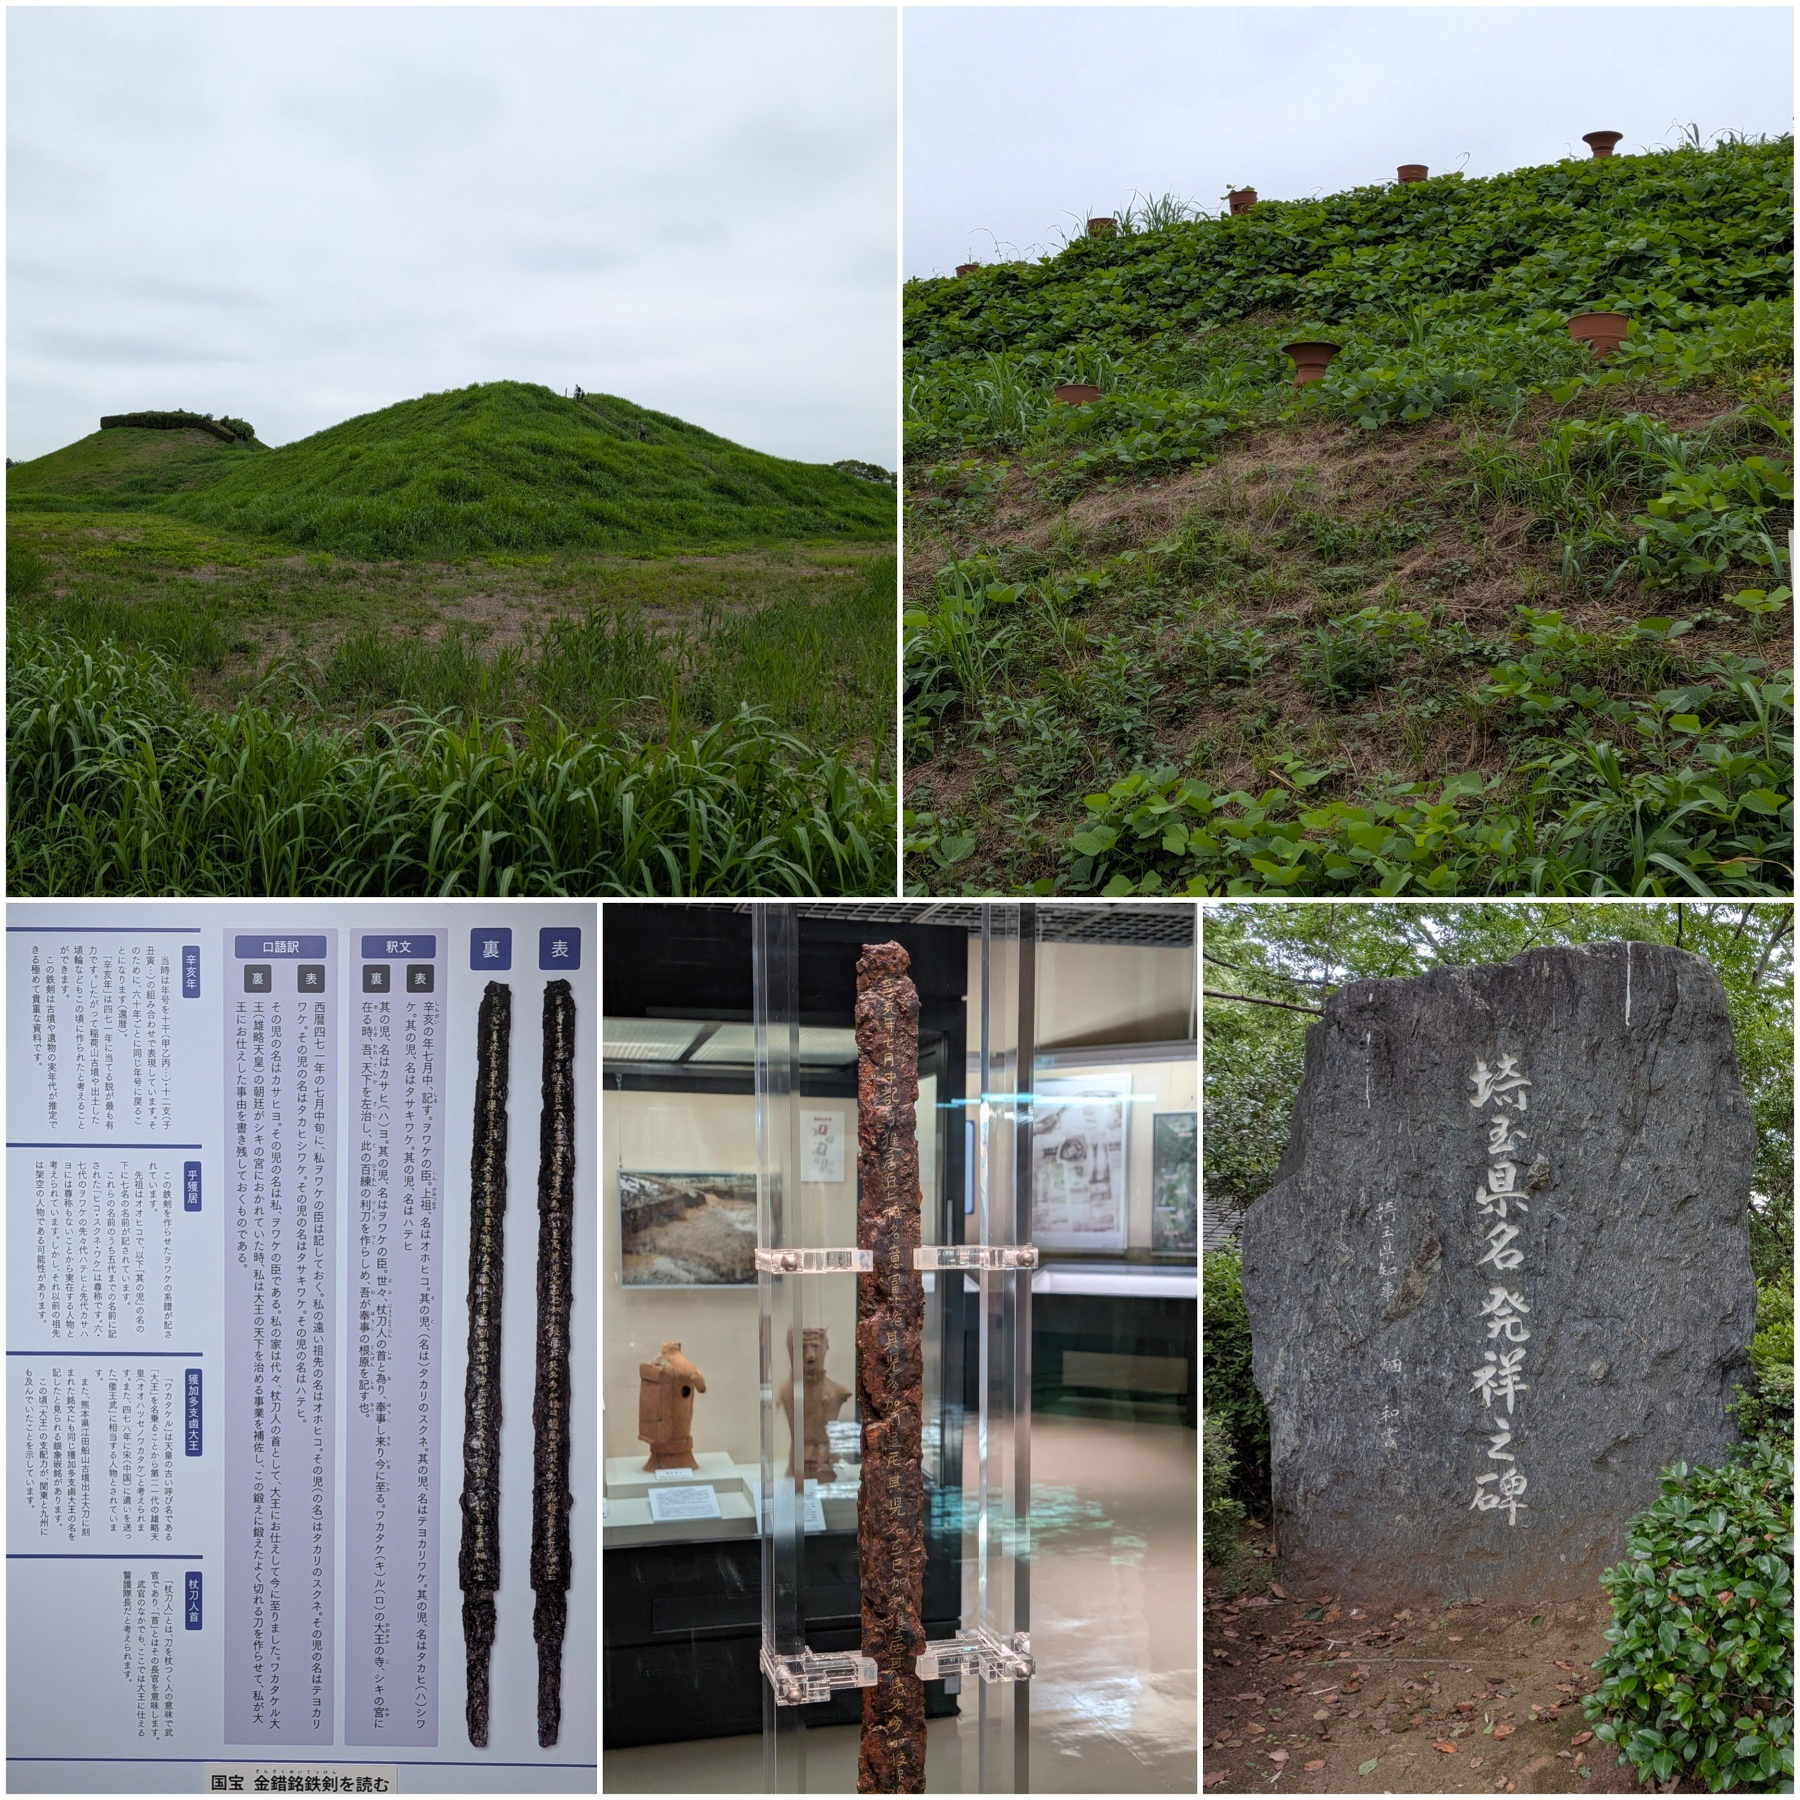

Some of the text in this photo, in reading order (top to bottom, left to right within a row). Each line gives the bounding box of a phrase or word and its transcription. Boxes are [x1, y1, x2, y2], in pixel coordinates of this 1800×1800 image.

[263, 941, 300, 954] 口語訳
[386, 940, 411, 953] 釈文
[483, 940, 500, 958] 裏
[552, 940, 568, 958] 表
[60, 946, 70, 998] ができます。
[186, 955, 196, 989] 辛亥年
[252, 972, 264, 985] 裏
[306, 972, 317, 985] 表
[370, 972, 382, 985] 裏
[414, 972, 426, 985] 表
[31, 946, 42, 1066] きる極めて貴重な資料です。
[149, 1162, 159, 1213] れています。
[188, 1170, 198, 1204] 乎獲居
[1376, 1201, 1397, 1301] 埼玉県知事
[1469, 1053, 1532, 1526] 埼玉県名発祥之碑
[95, 1368, 104, 1382] す。
[188, 1374, 199, 1450] 獲加多支鹵大王
[25, 1368, 35, 1510] も及んでいたことを示しています。
[188, 1579, 199, 1622] 杖刀人首
[123, 1570, 133, 1683] 警護隊長だと考えられます。
[212, 1775, 390, 1793] 国宝 金錯銘鉄剣を読む
